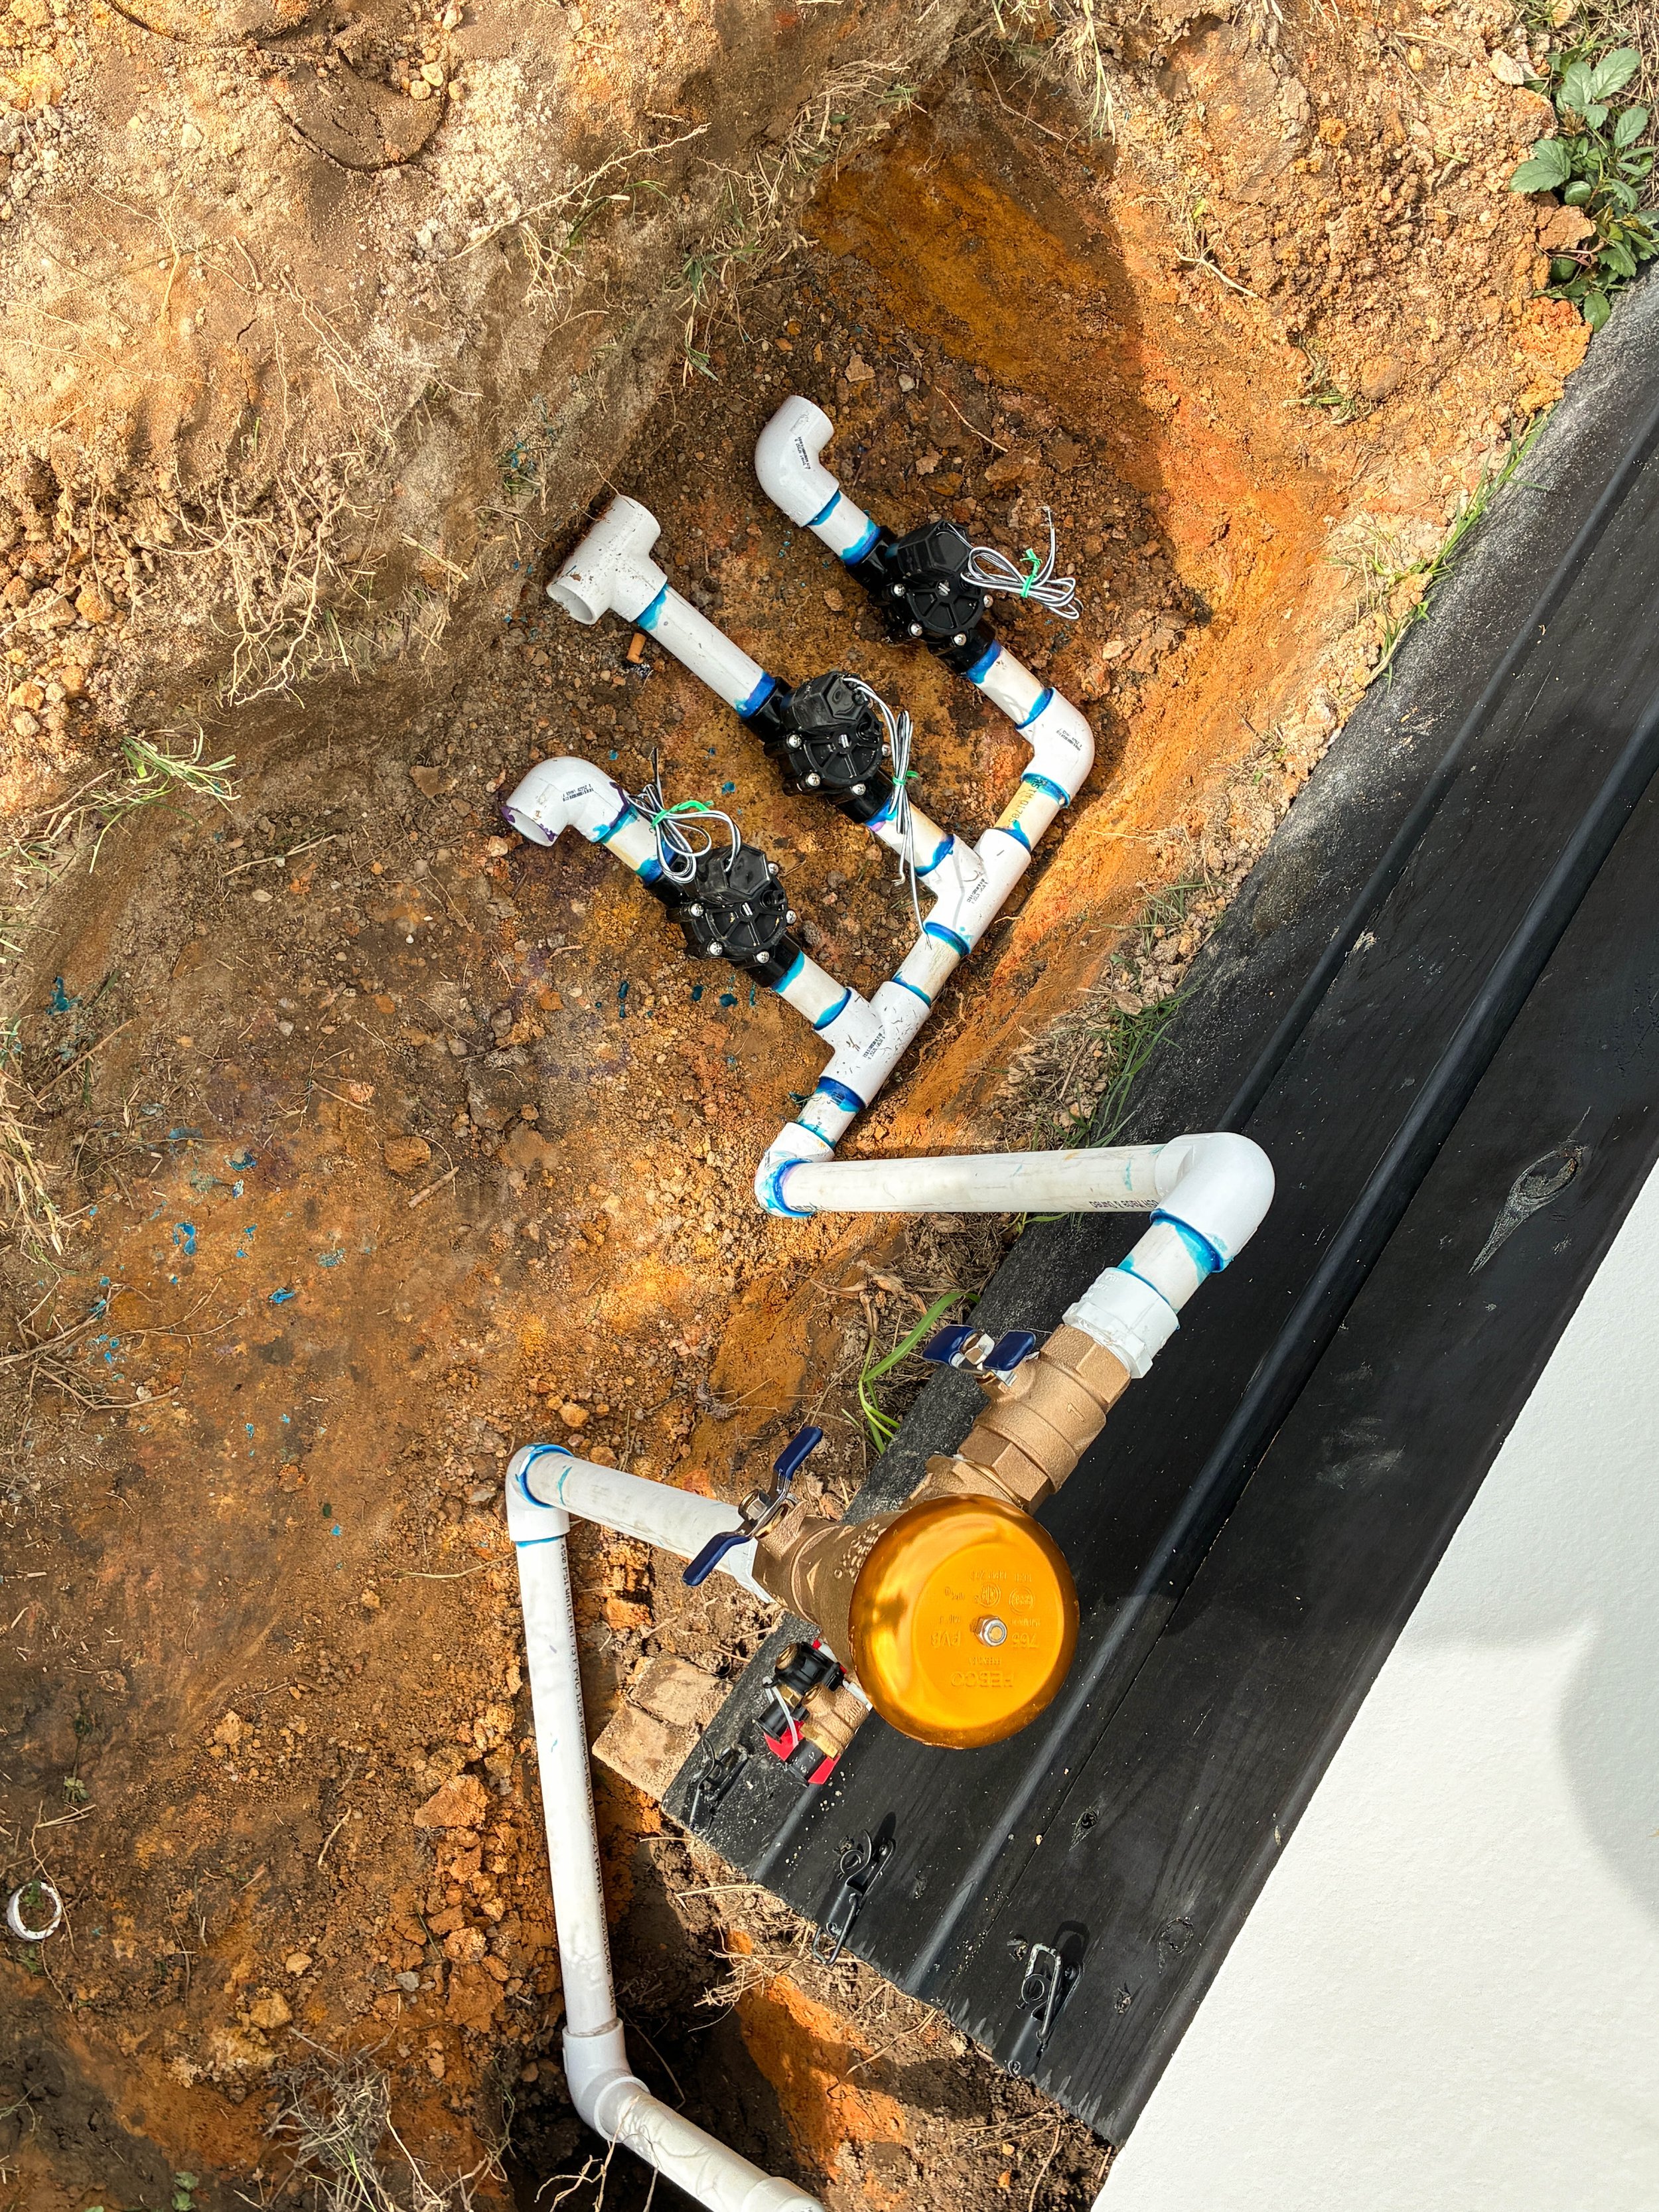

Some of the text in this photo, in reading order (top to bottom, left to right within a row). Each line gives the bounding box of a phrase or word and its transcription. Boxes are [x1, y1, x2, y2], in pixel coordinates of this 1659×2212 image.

[930, 1630, 1040, 1649] 765 PVB
[952, 1670, 1014, 1688] FEBCO
